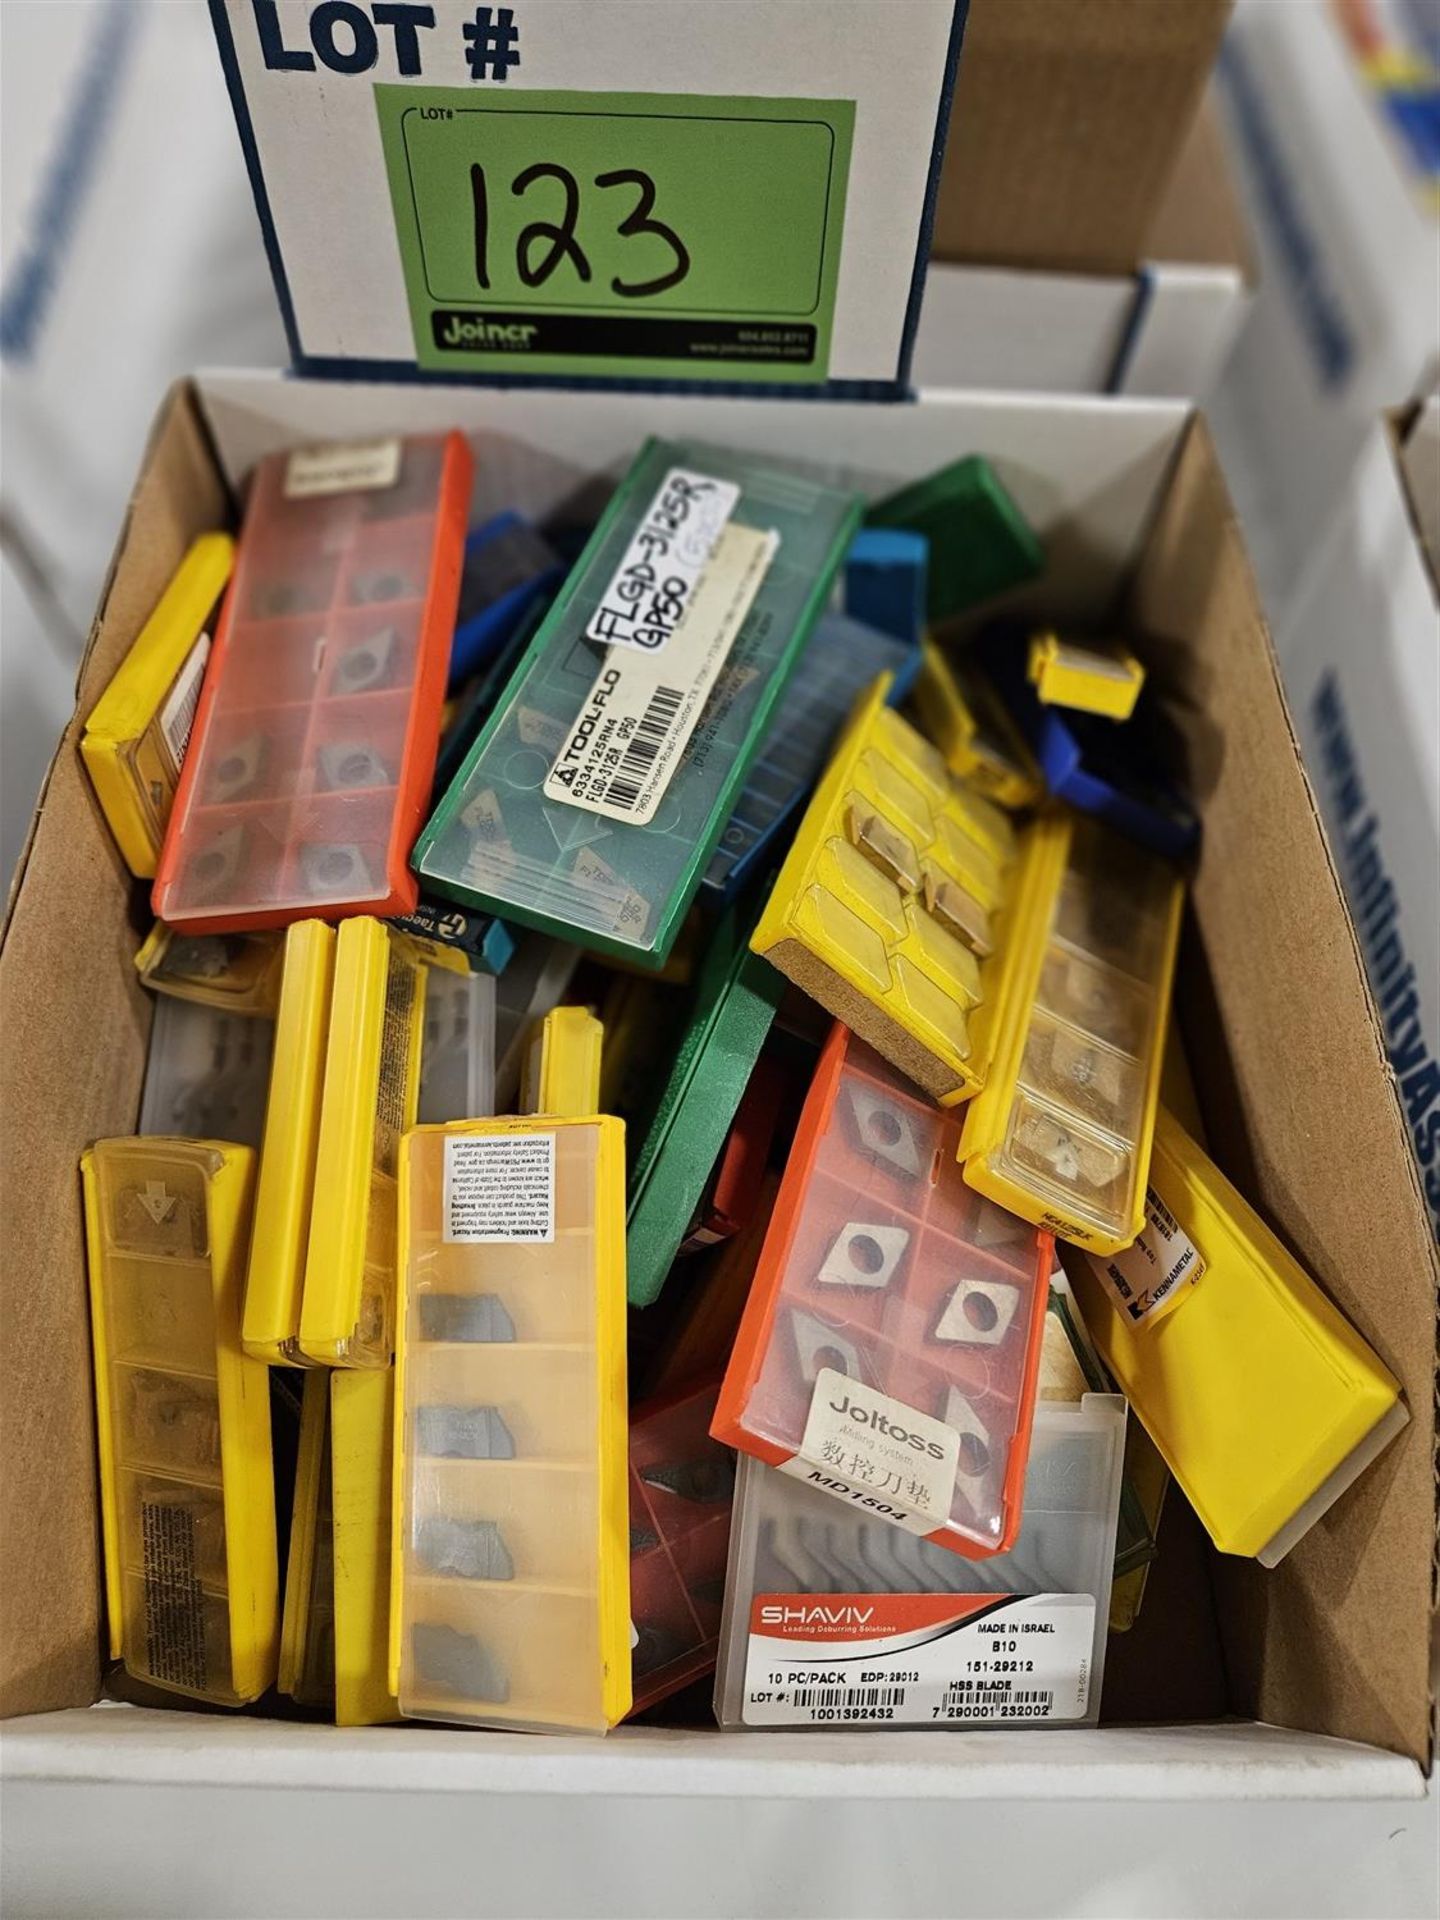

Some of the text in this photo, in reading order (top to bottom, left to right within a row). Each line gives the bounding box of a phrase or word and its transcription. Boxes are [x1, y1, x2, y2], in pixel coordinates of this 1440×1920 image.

[256, 0, 520, 82] LOT #
[420, 106, 454, 121] LOT#
[470, 161, 691, 297] 123
[594, 476, 719, 643] FLGD-3125R
[631, 574, 688, 651] GP50
[571, 717, 620, 799] 6334125RN4
[584, 716, 638, 805] FLGD-3125R GP50
[634, 792, 652, 815] 7803
[644, 761, 667, 794] Hansen
[659, 739, 677, 762] Road
[1152, 1248, 1195, 1300] KENNAMETAL
[829, 1397, 946, 1461] Joltoss
[819, 1437, 932, 1512] 数控刀垫
[806, 1470, 909, 1523] MD1504
[760, 1605, 874, 1625] SHAVIV
[783, 1624, 816, 1635] Leading
[977, 1623, 1056, 1634] MADE IN ISRAEL
[992, 1640, 1017, 1653] B10
[767, 1673, 784, 1685] 10
[787, 1672, 847, 1685] PC/PACK
[966, 1659, 1034, 1673] 151-29212
[750, 1692, 774, 1703] LOT
[949, 1680, 1012, 1691] HSS BLADE
[809, 1708, 895, 1720] 1001392432
[932, 1706, 1050, 1720] 7 290001 232002
